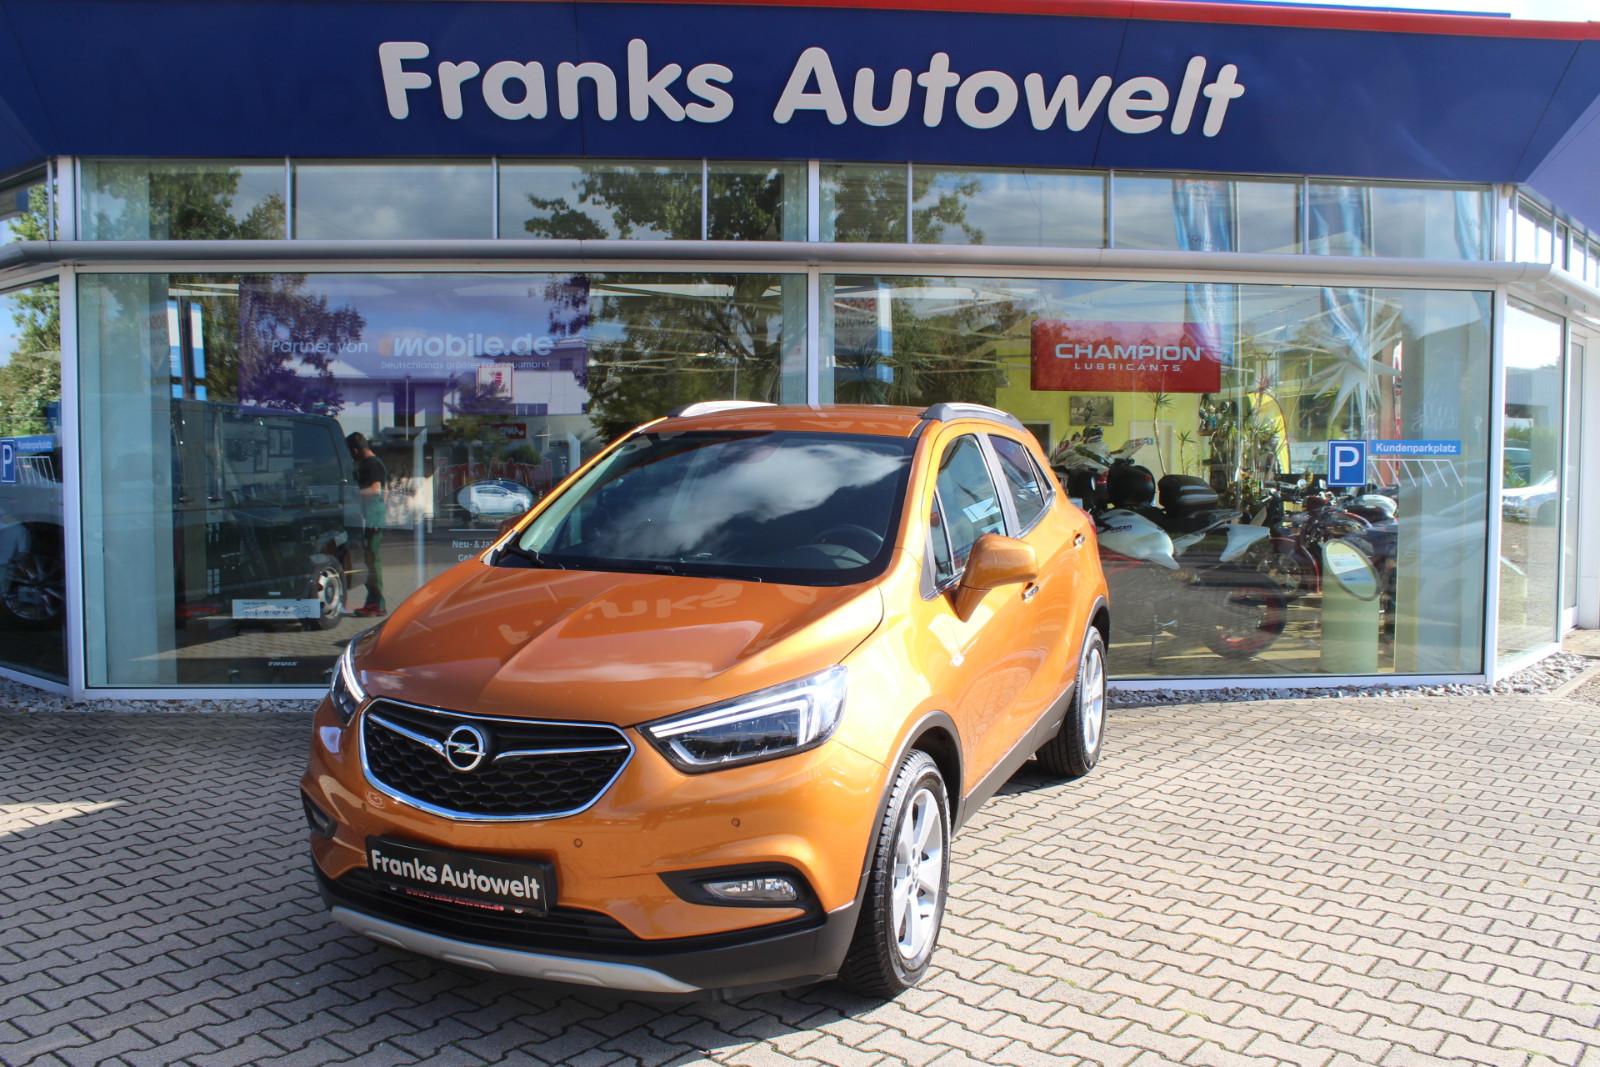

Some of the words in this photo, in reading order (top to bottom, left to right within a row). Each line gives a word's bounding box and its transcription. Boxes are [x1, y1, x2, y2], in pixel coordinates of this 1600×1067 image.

[378, 38, 735, 123] Franks
[772, 46, 1245, 138] Autowelt
[271, 339, 333, 353] Partner
[339, 341, 369, 353] von
[1055, 343, 1201, 361] CHAMPION
[1074, 362, 1182, 372] LUBRICANTS
[1375, 443, 1457, 454] Kundenparkplatz
[1334, 446, 1360, 480] P
[371, 849, 437, 884] Franks
[441, 863, 540, 900] Autowelt
